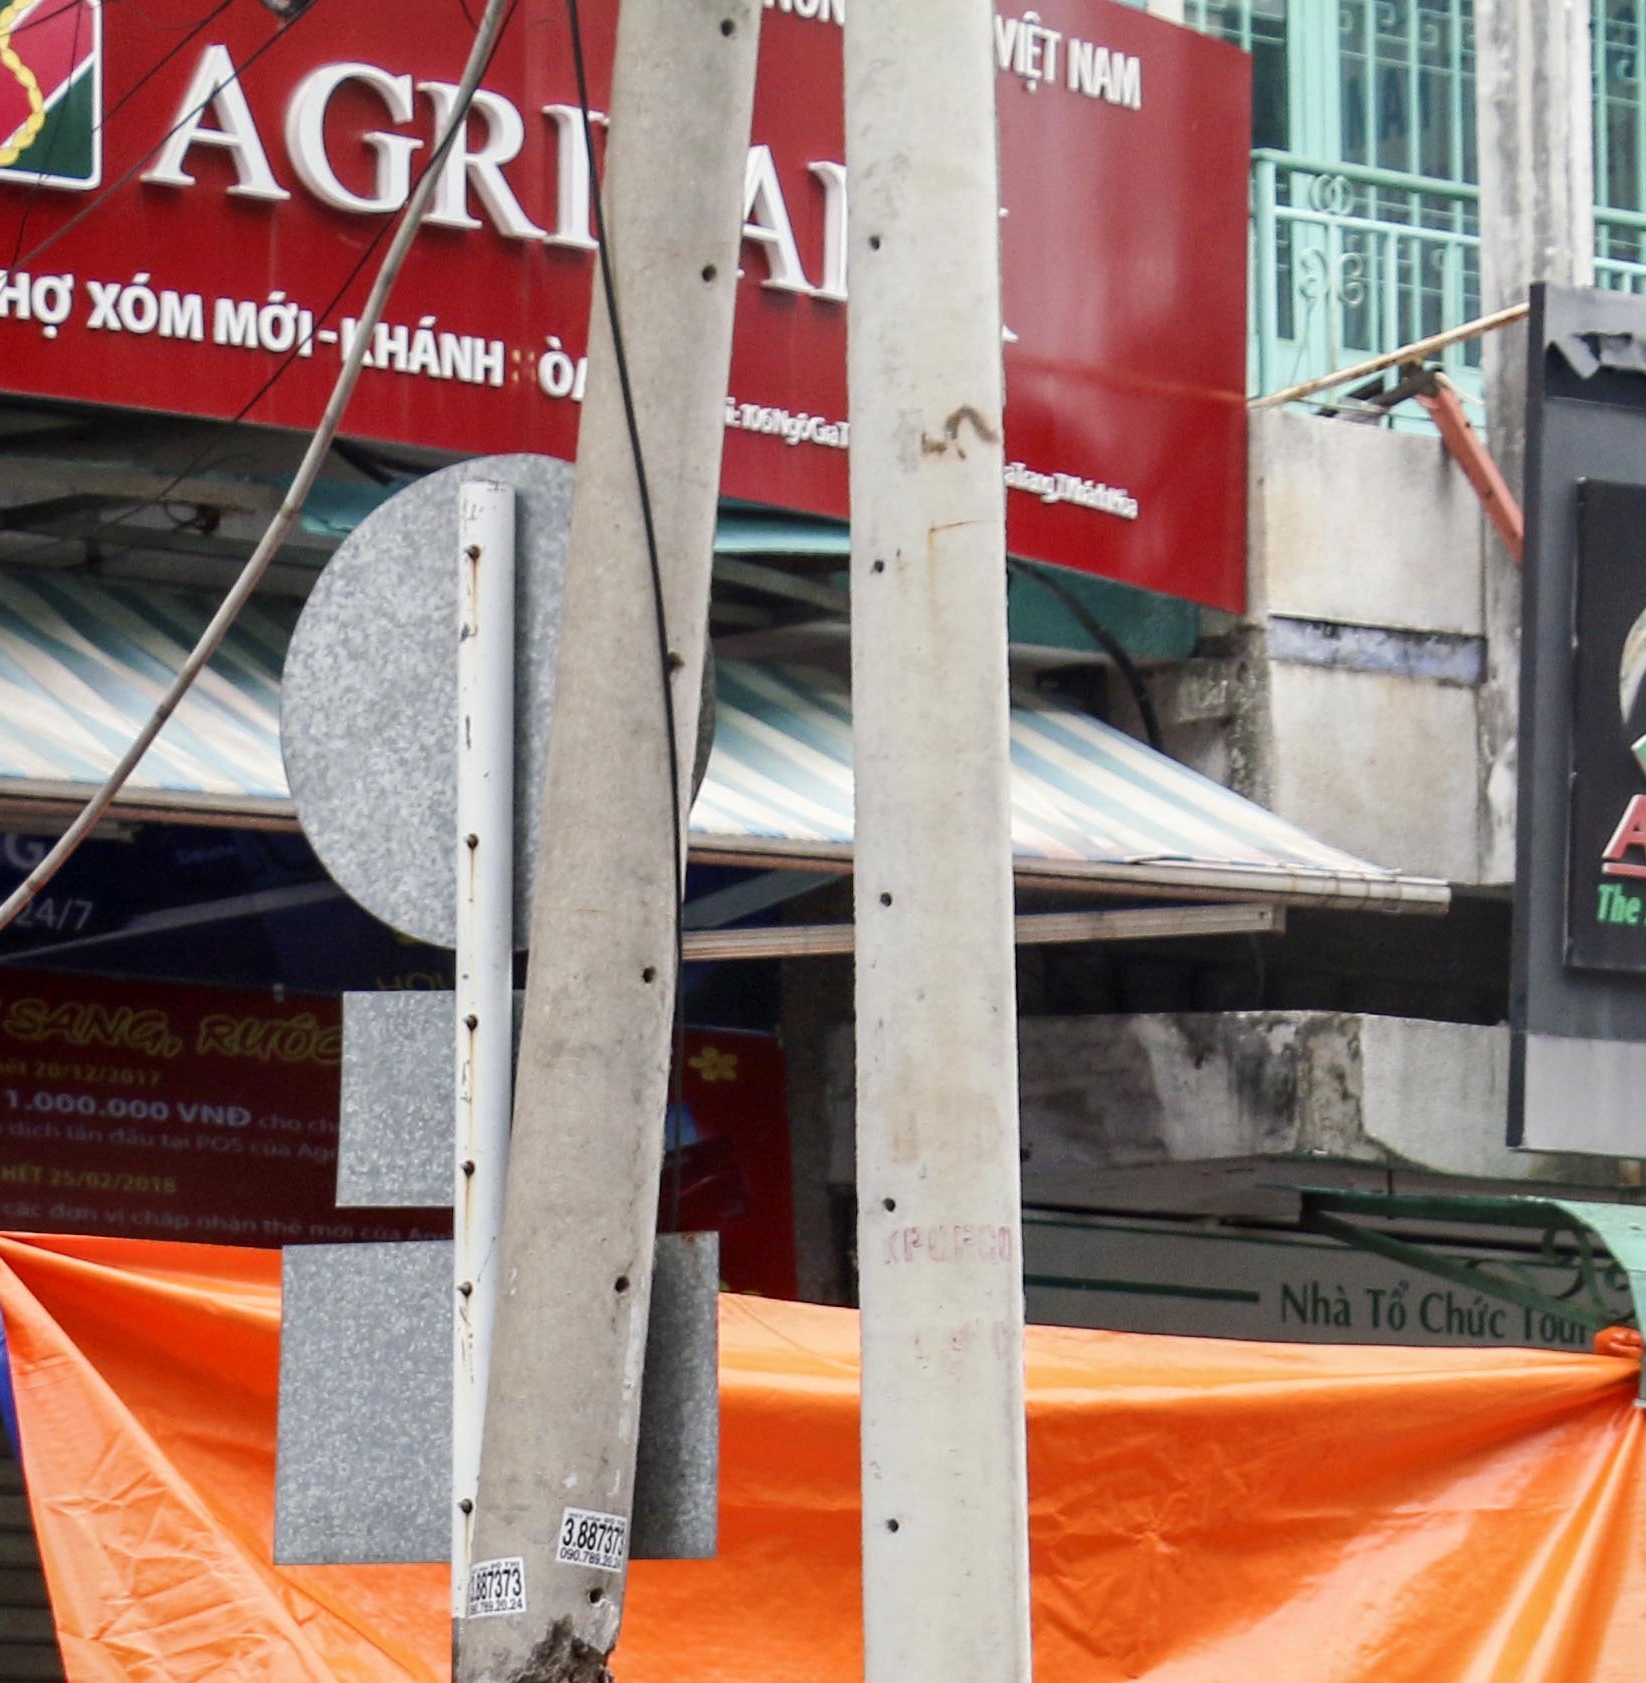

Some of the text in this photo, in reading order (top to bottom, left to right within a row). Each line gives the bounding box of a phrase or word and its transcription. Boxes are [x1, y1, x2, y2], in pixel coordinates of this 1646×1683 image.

[1068, 37, 1143, 111] NAM
[86, 270, 204, 342] XÓM
[1597, 883, 1642, 926] The
[4, 1086, 170, 1121] 1.000.000
[1280, 1280, 1352, 1327] Nhà
[1419, 1288, 1508, 1341] Chức
